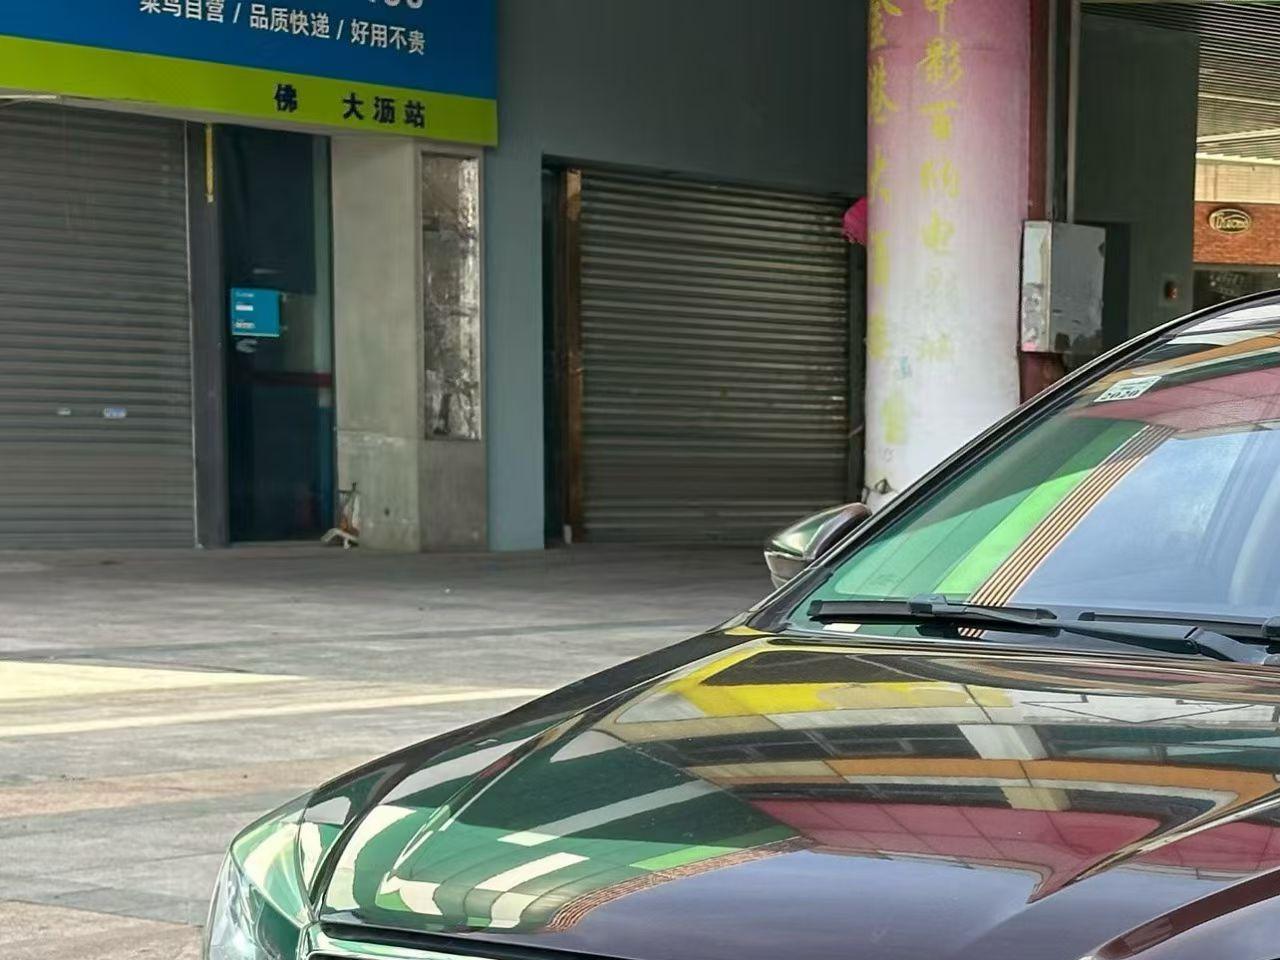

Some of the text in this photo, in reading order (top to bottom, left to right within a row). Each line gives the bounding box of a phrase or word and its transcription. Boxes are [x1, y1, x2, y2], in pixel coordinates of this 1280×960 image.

[250, 3, 330, 39] 品质快递
[350, 18, 425, 56] 好用不贵
[274, 83, 425, 129] 佛 大沥站
